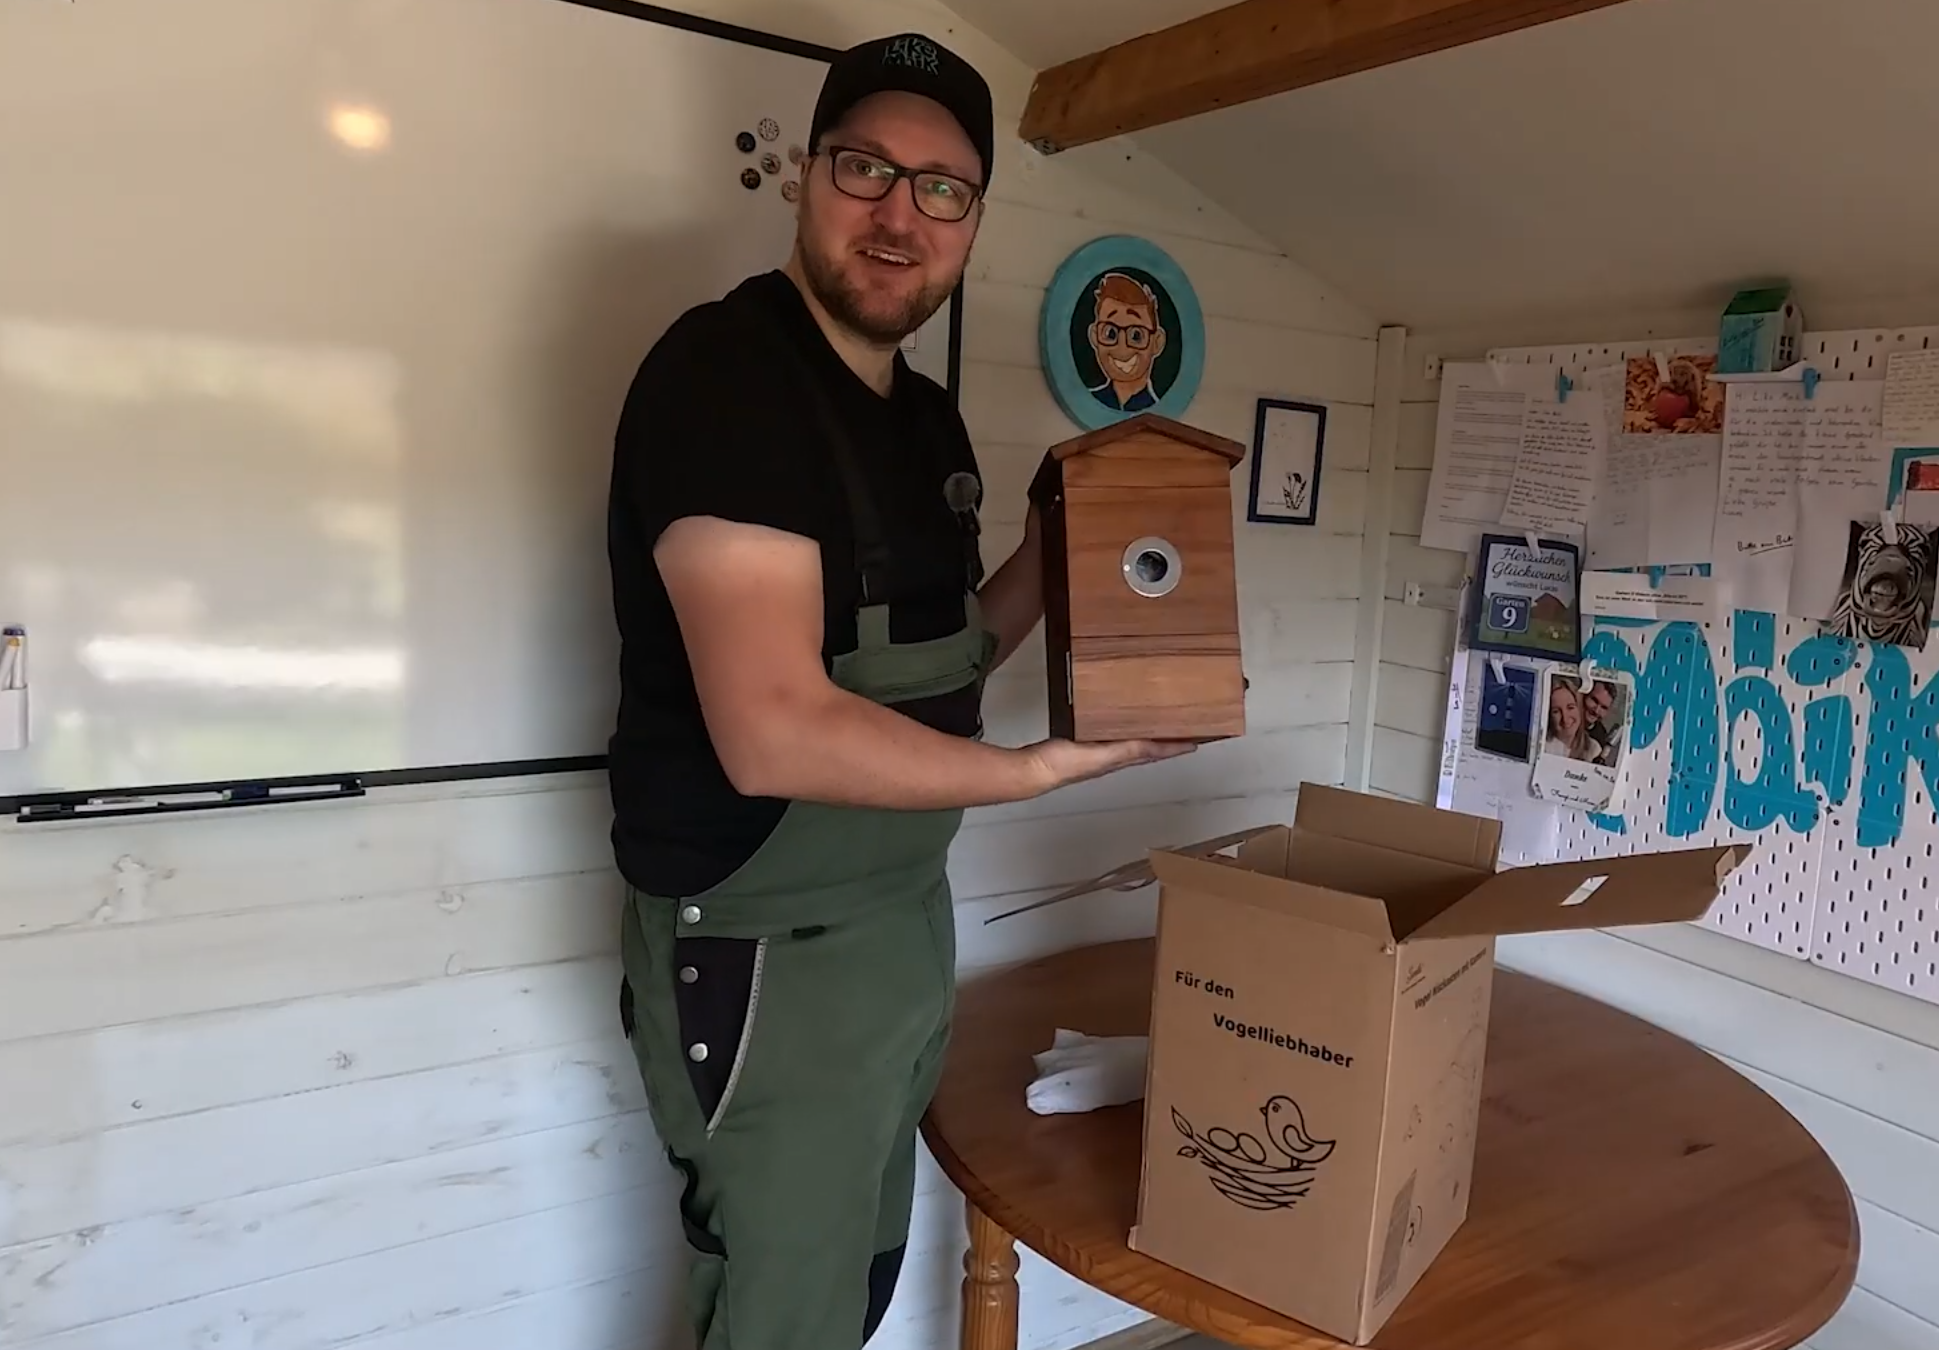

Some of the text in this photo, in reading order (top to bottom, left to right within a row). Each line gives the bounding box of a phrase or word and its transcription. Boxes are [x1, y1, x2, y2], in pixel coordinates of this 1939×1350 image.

[1492, 561, 1571, 583] Glückwunsch
[1506, 580, 1538, 590] wünscht
[1496, 597, 1526, 607] Garten
[1502, 606, 1517, 628] 9
[1175, 970, 1235, 999] Für den
[1213, 1012, 1354, 1068] Vogelliebhaber
